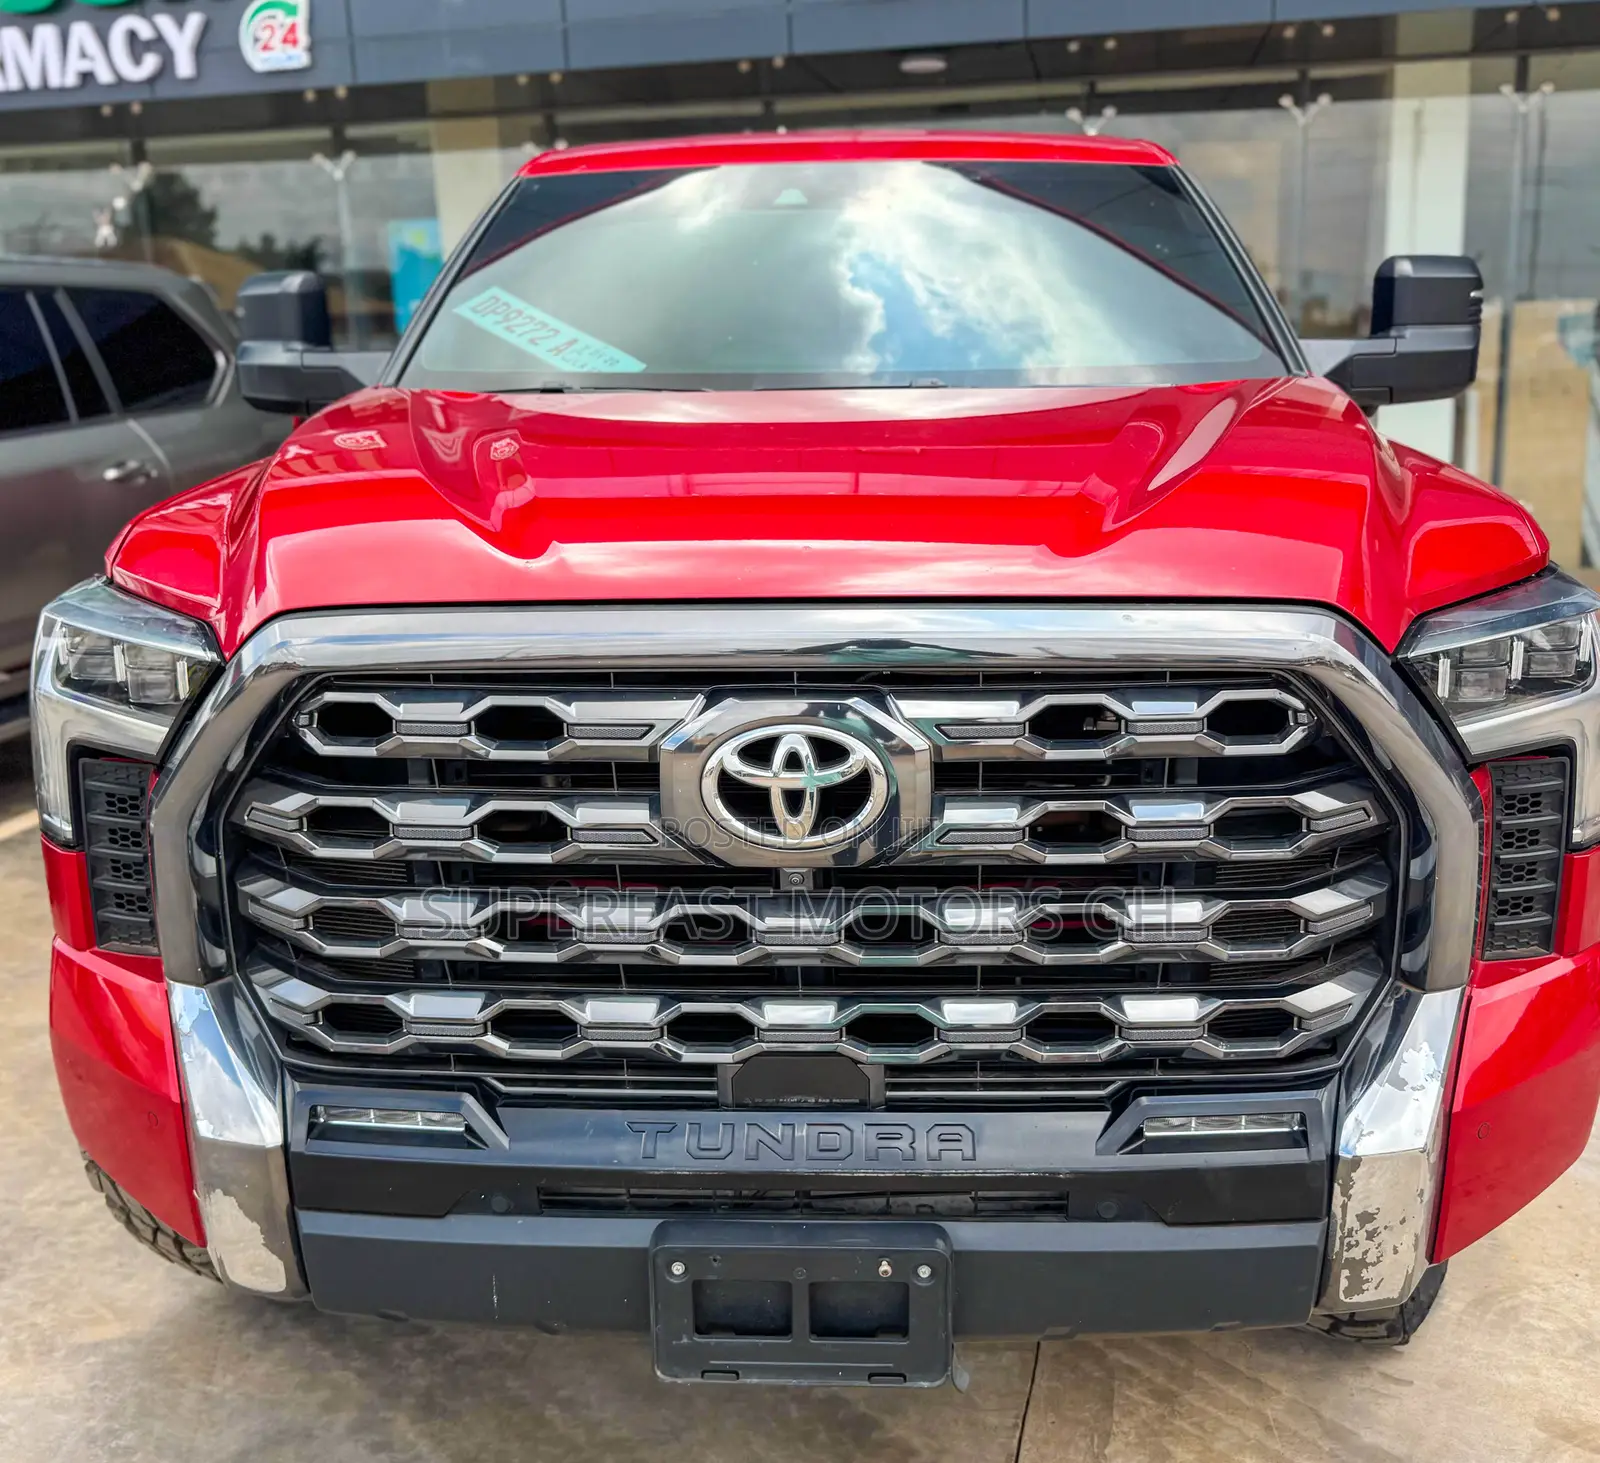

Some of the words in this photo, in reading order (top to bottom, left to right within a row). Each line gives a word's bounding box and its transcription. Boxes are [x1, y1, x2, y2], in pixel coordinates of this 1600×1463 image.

[0, 11, 207, 92] MACY
[259, 22, 299, 52] 24
[625, 1121, 977, 1162] TUNDRA
